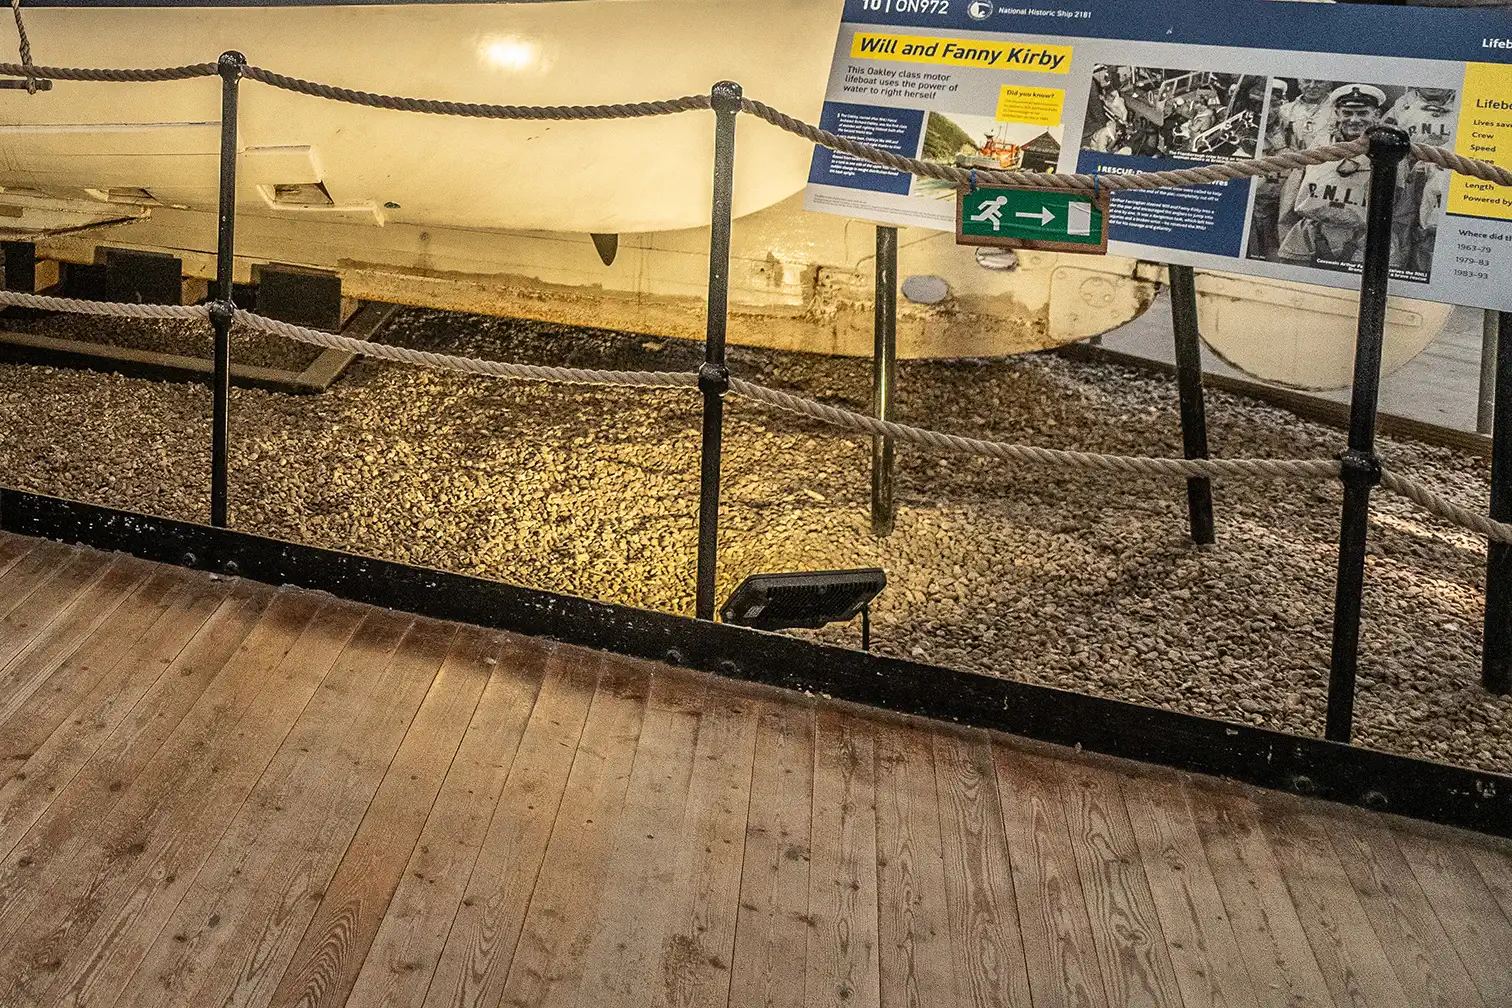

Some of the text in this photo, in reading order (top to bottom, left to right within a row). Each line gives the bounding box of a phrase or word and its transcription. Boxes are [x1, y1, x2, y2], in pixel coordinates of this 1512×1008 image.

[998, 6, 1027, 15] National
[1028, 8, 1055, 17] Historic
[1056, 9, 1073, 18] Ship
[860, 37, 1065, 70] Will and Fanny Kirby
[847, 65, 951, 82] This Oakley class motor
[844, 75, 958, 92] lifeboat uses the power of
[843, 85, 937, 100] water to right herself
[1471, 131, 1494, 139] Crew
[1470, 144, 1496, 152] Speed
[1464, 182, 1494, 191] Length
[1463, 194, 1501, 205] Powered
[1458, 229, 1487, 239] Where
[1489, 233, 1503, 241] did
